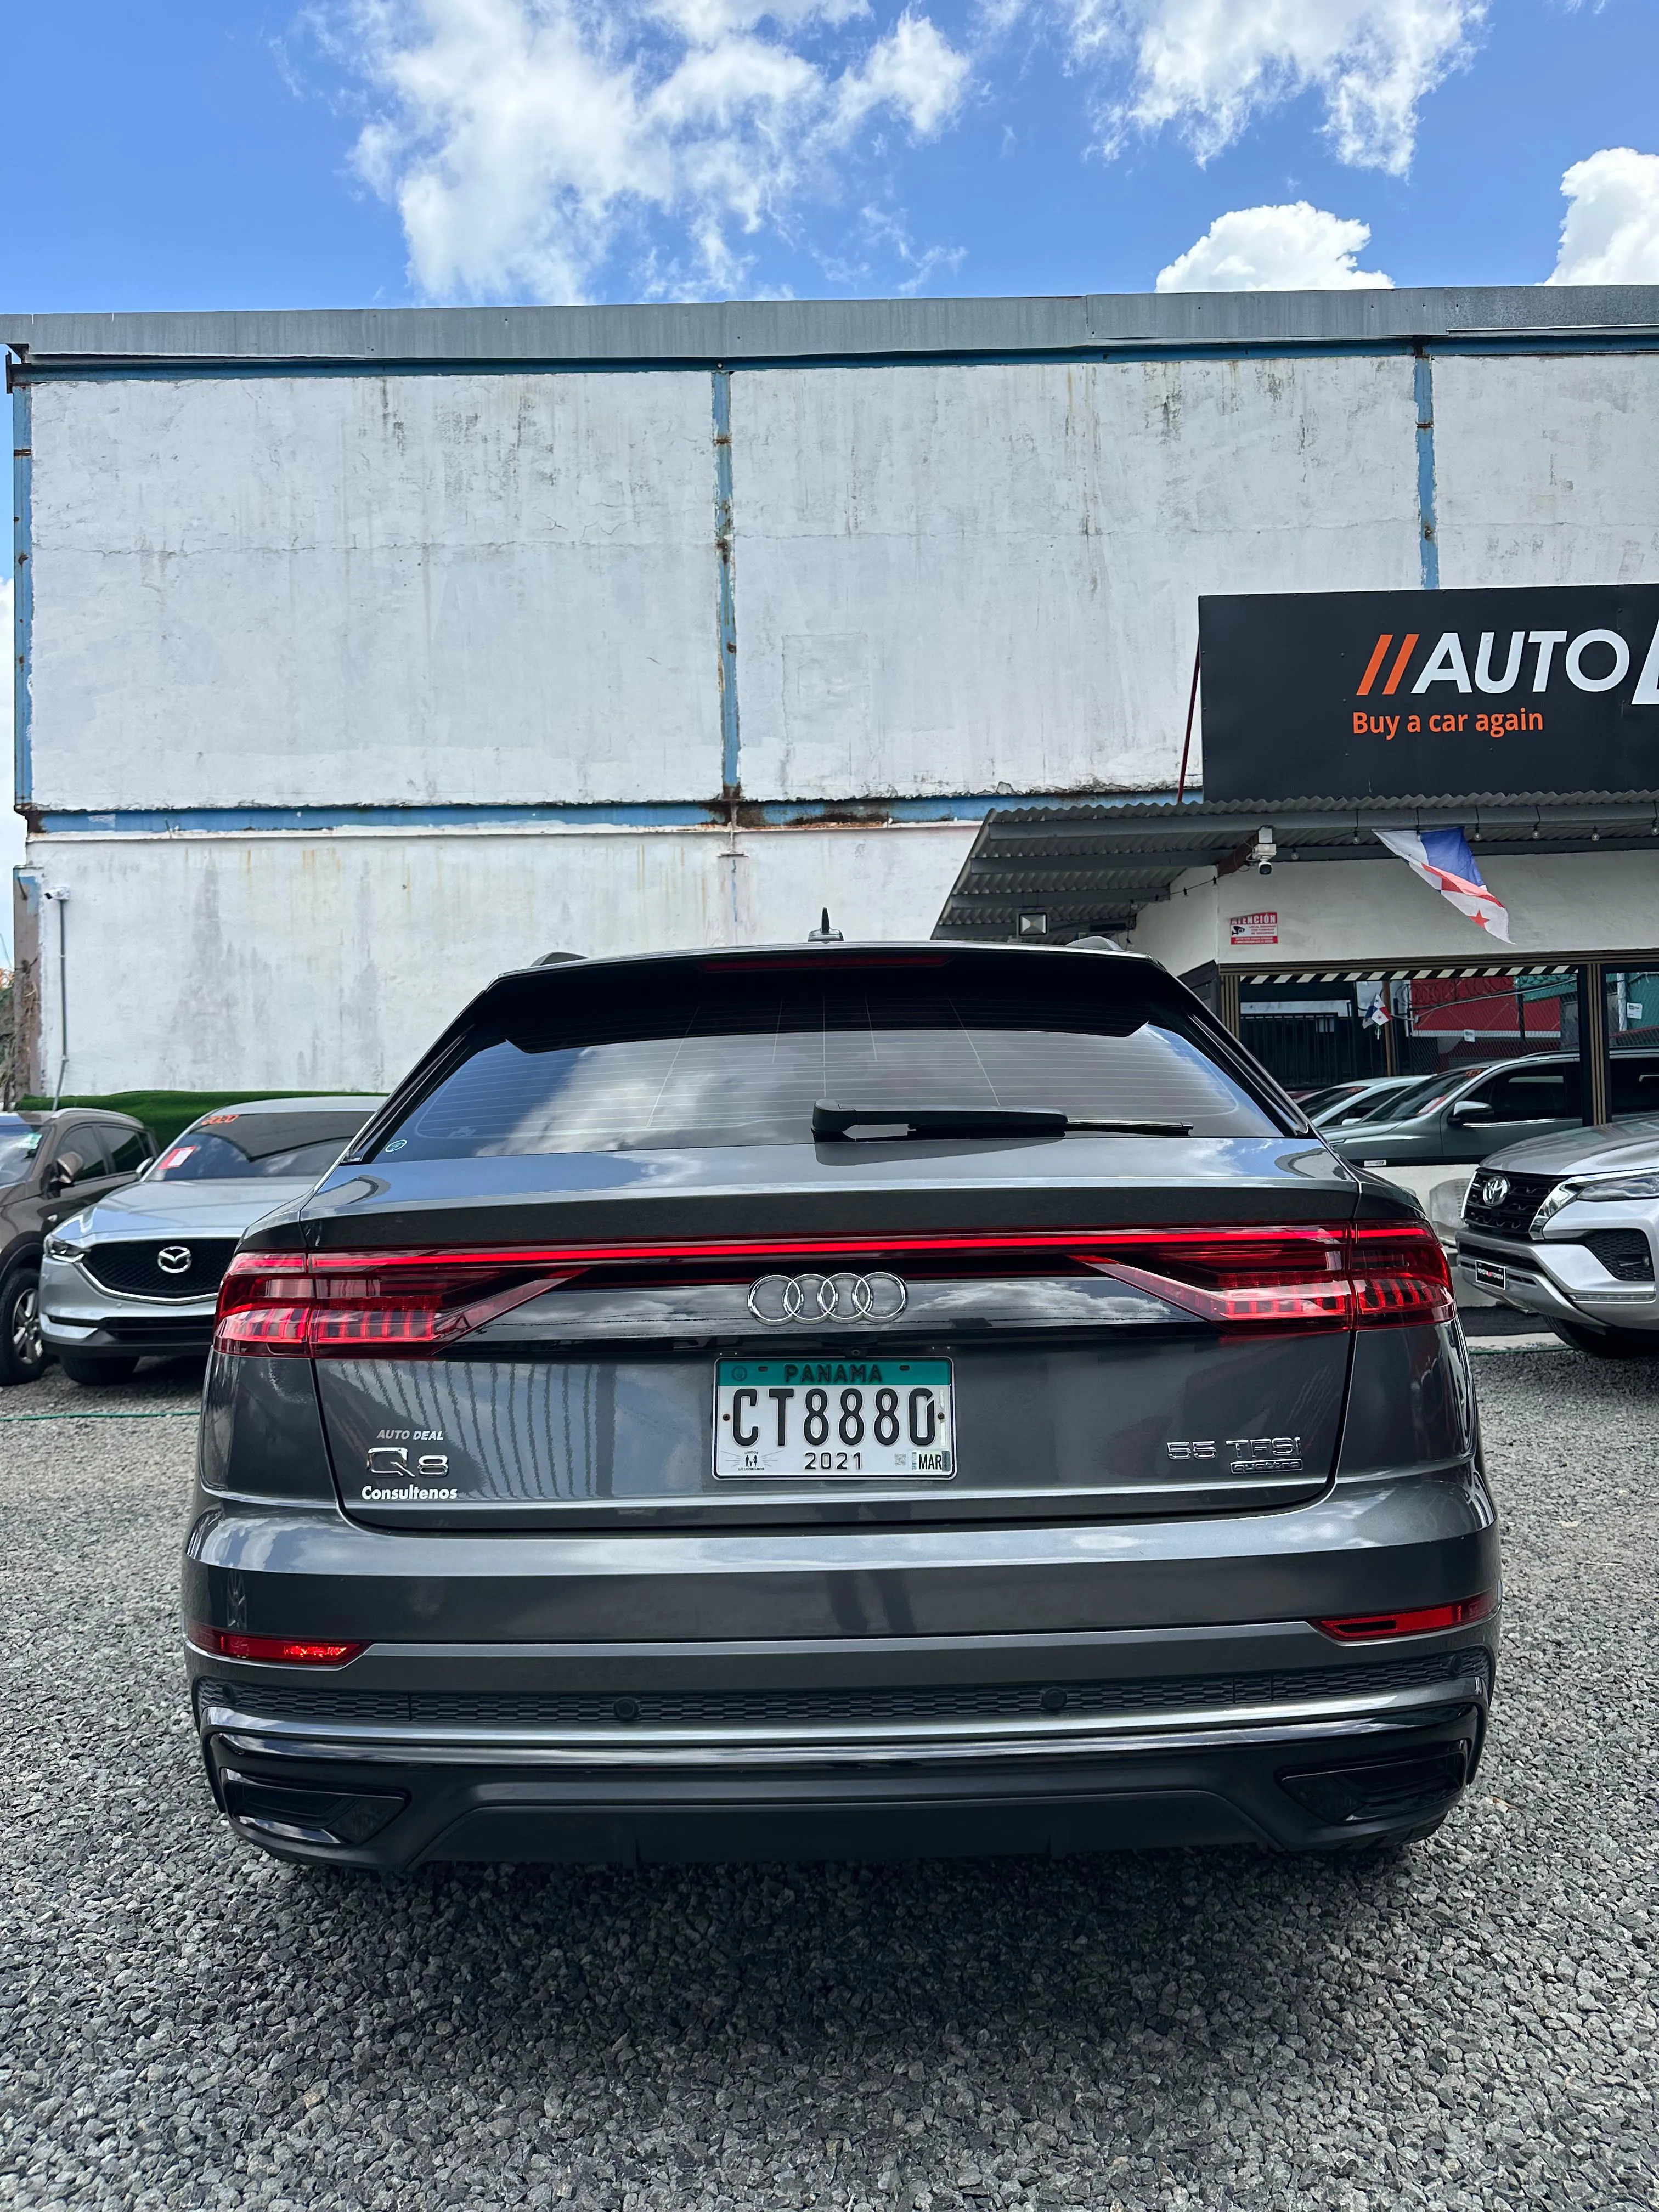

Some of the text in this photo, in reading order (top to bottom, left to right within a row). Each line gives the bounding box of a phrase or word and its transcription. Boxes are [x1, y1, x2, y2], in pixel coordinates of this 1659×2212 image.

[1353, 707, 1543, 740] Buy a car again
[783, 1363, 882, 1383] PANAMA
[733, 1387, 935, 1447] CT8880
[376, 1430, 444, 1441] AUTO DEAL
[1167, 1437, 1302, 1460] 55 TFSI
[366, 1447, 449, 1477] Q8
[804, 1452, 862, 1470] 2021
[919, 1454, 942, 1470] MAR
[1234, 1460, 1301, 1473] quattro
[362, 1484, 458, 1500] Consultenos
